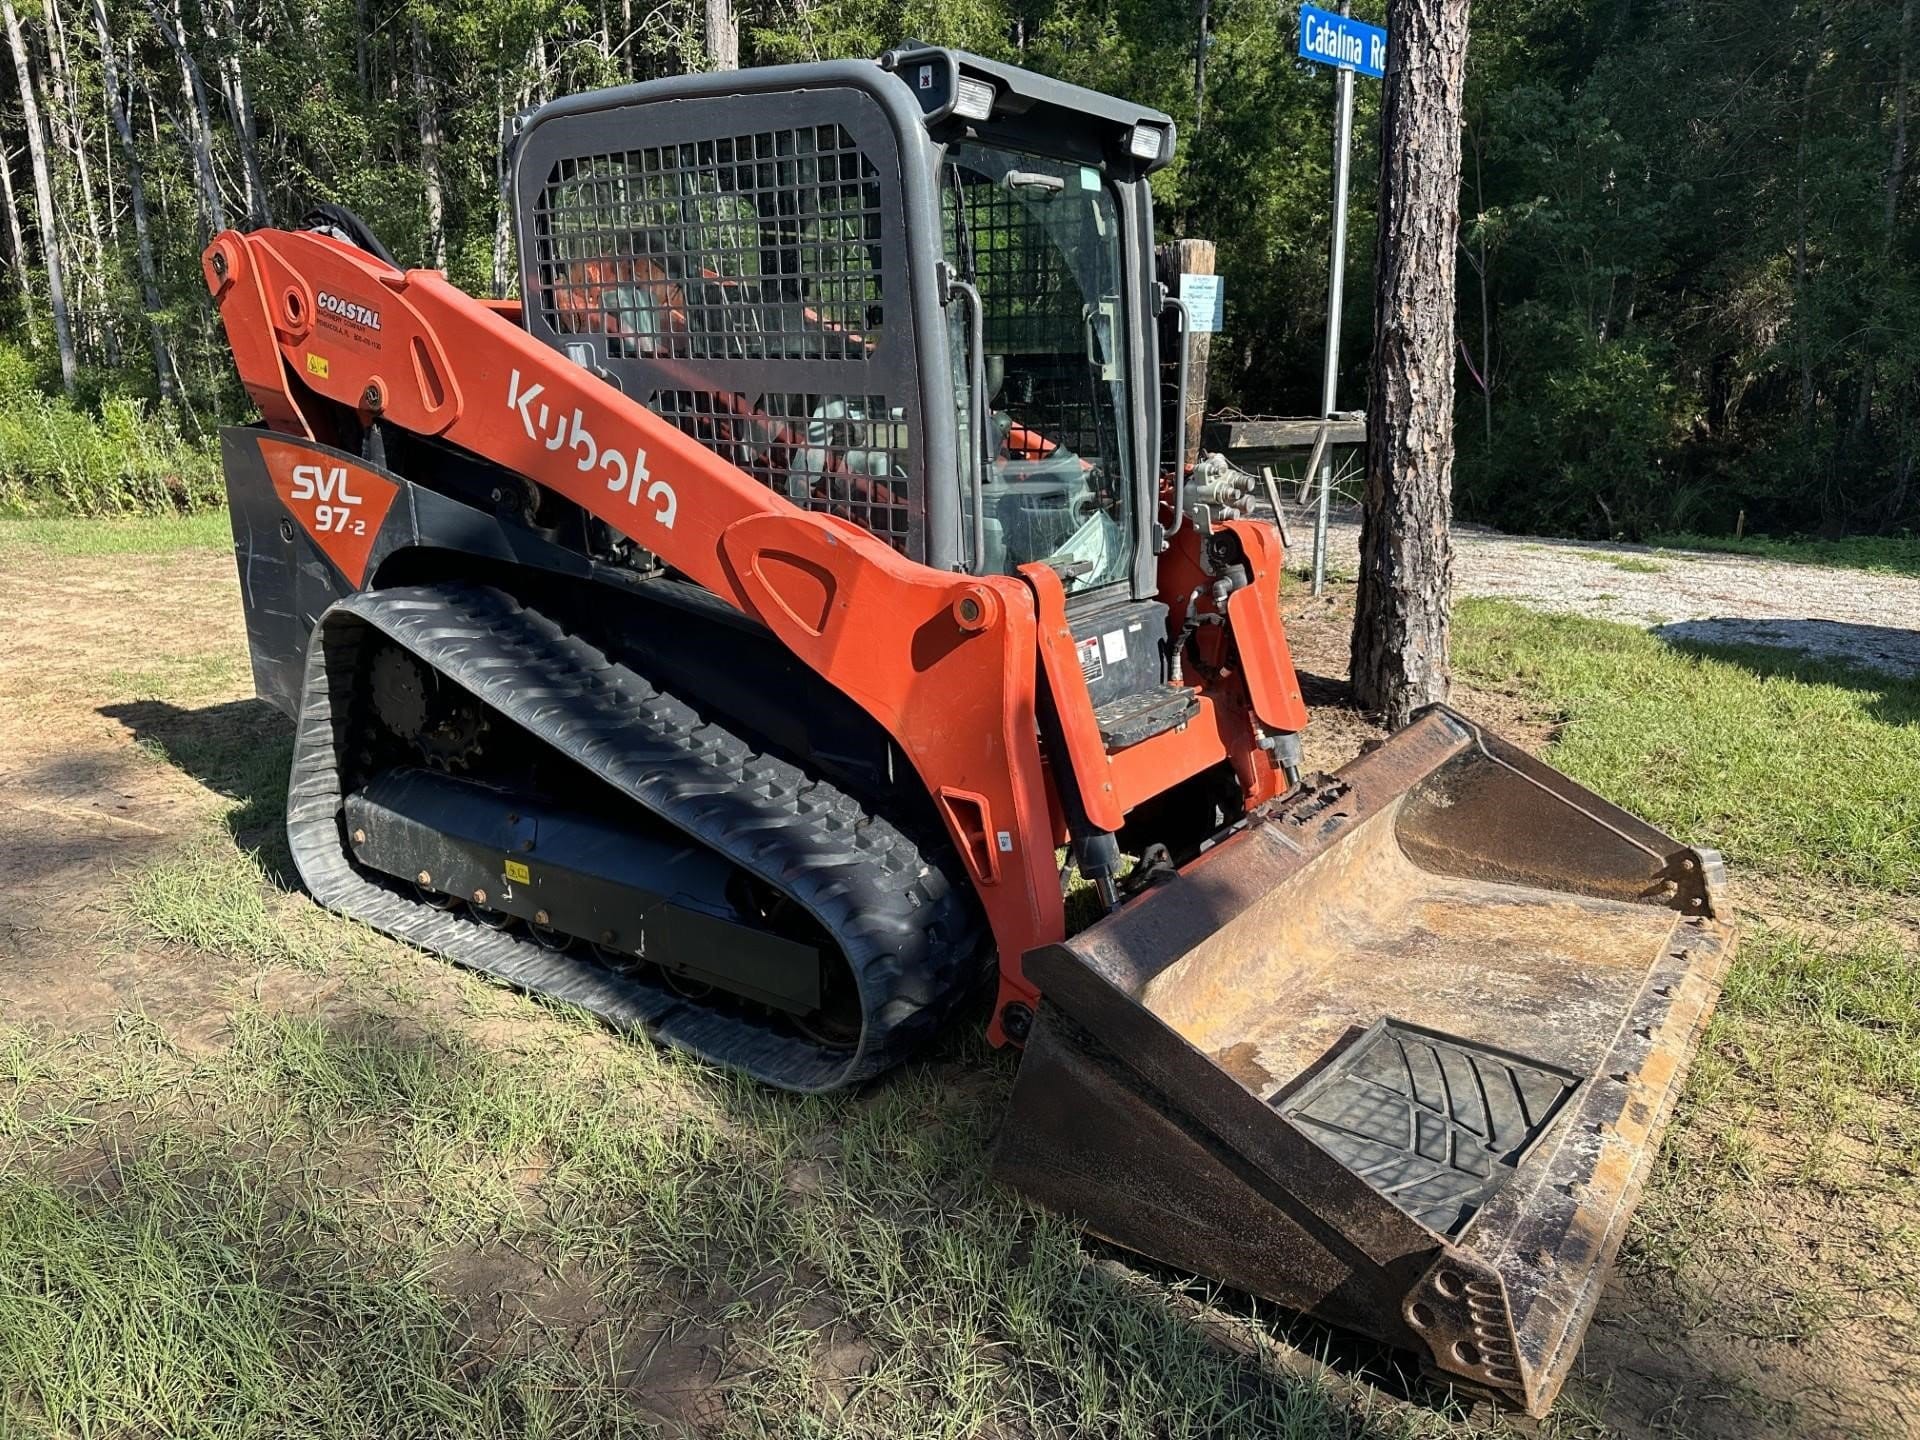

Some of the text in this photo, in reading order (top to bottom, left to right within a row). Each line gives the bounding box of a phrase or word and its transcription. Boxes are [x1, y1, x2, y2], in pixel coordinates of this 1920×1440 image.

[1305, 14, 1363, 65] Catalina
[317, 291, 382, 331] COASTAL
[507, 368, 678, 530] Kubota
[291, 465, 363, 505] SVL
[315, 504, 366, 536] 97-2
